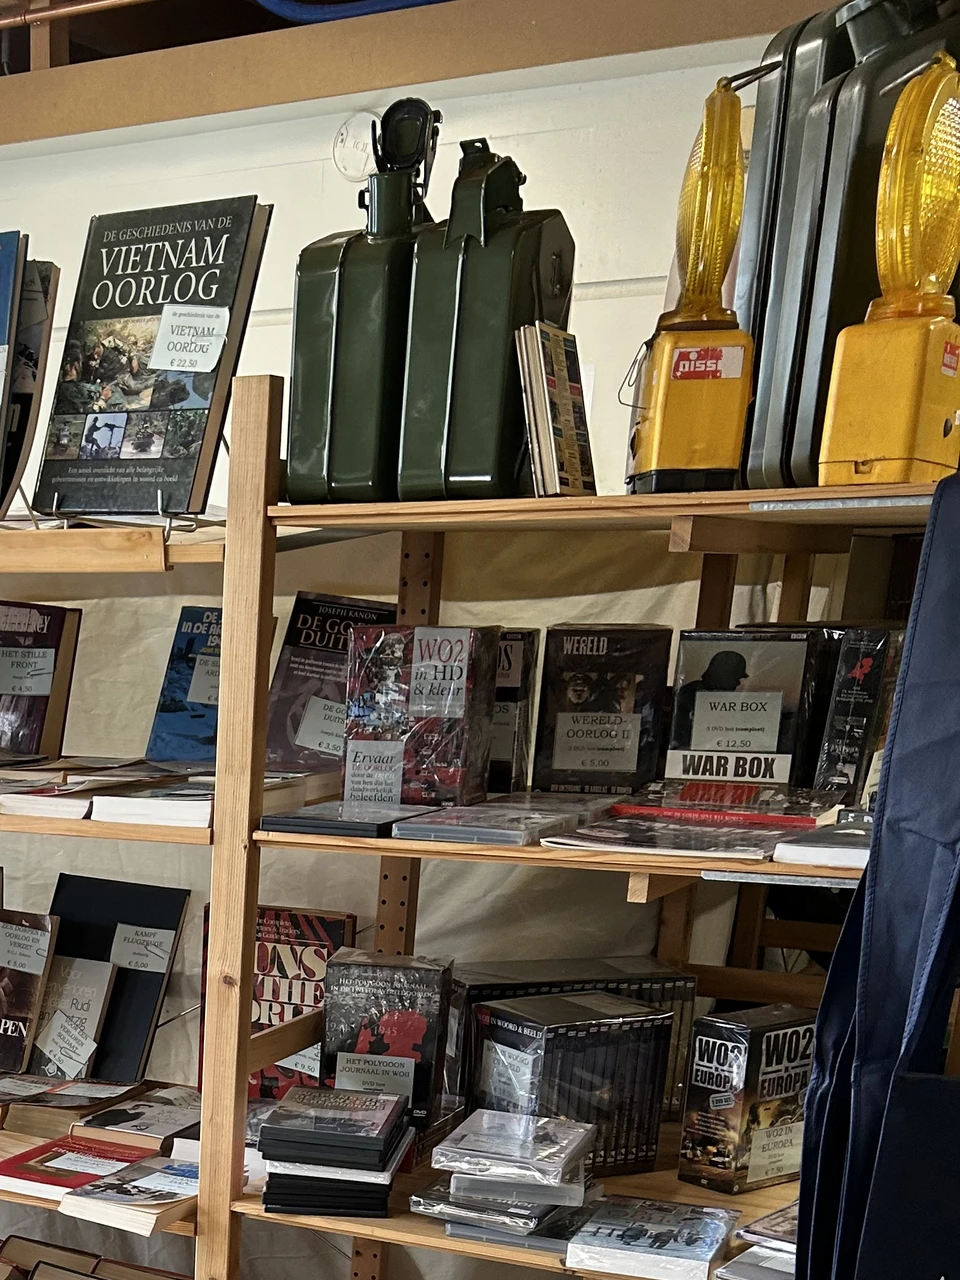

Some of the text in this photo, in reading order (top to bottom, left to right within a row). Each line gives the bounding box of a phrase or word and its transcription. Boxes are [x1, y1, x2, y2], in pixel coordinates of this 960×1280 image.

[103, 216, 233, 242] DE GESCHIEDENIS VAN DE
[100, 234, 230, 276] VIETNAM
[92, 269, 220, 310] OORLOG
[170, 325, 215, 337] VIETNAM
[319, 605, 347, 617] JOSEPH
[297, 614, 323, 631] DE
[418, 638, 464, 662] WO2
[563, 636, 608, 655] WERELD
[21, 651, 47, 659] STILLE
[11, 661, 38, 669] FRONT
[414, 665, 463, 681] in HD
[413, 685, 425, 696] &
[323, 704, 334, 712] DE
[709, 702, 768, 712] WAR BOX
[571, 715, 627, 725] WERELD-
[566, 729, 617, 739] OORLOG
[318, 741, 341, 751] € 3,50
[716, 739, 751, 748] € 12,50
[581, 759, 586, 767] €
[682, 755, 775, 779] WAR BOX
[5, 932, 30, 942] OORLOG
[135, 930, 158, 938] KAMPF
[9, 941, 33, 951] VERZET
[12, 961, 27, 969] 5,00
[134, 961, 148, 969] 5,00
[256, 974, 327, 1007] THE
[70, 998, 92, 1011] Rudi
[490, 1016, 543, 1040] IN WOORD & BEELD
[765, 1027, 814, 1068] WO2
[53, 1053, 64, 1065] 4,50
[346, 1057, 405, 1069] HET POLYGOON
[294, 1061, 315, 1073] € 9,50
[339, 1066, 380, 1075] JOURNAAL
[760, 1071, 808, 1101] EUROPA
[766, 1128, 783, 1139] WO2
[761, 1139, 794, 1152] EUROPA
